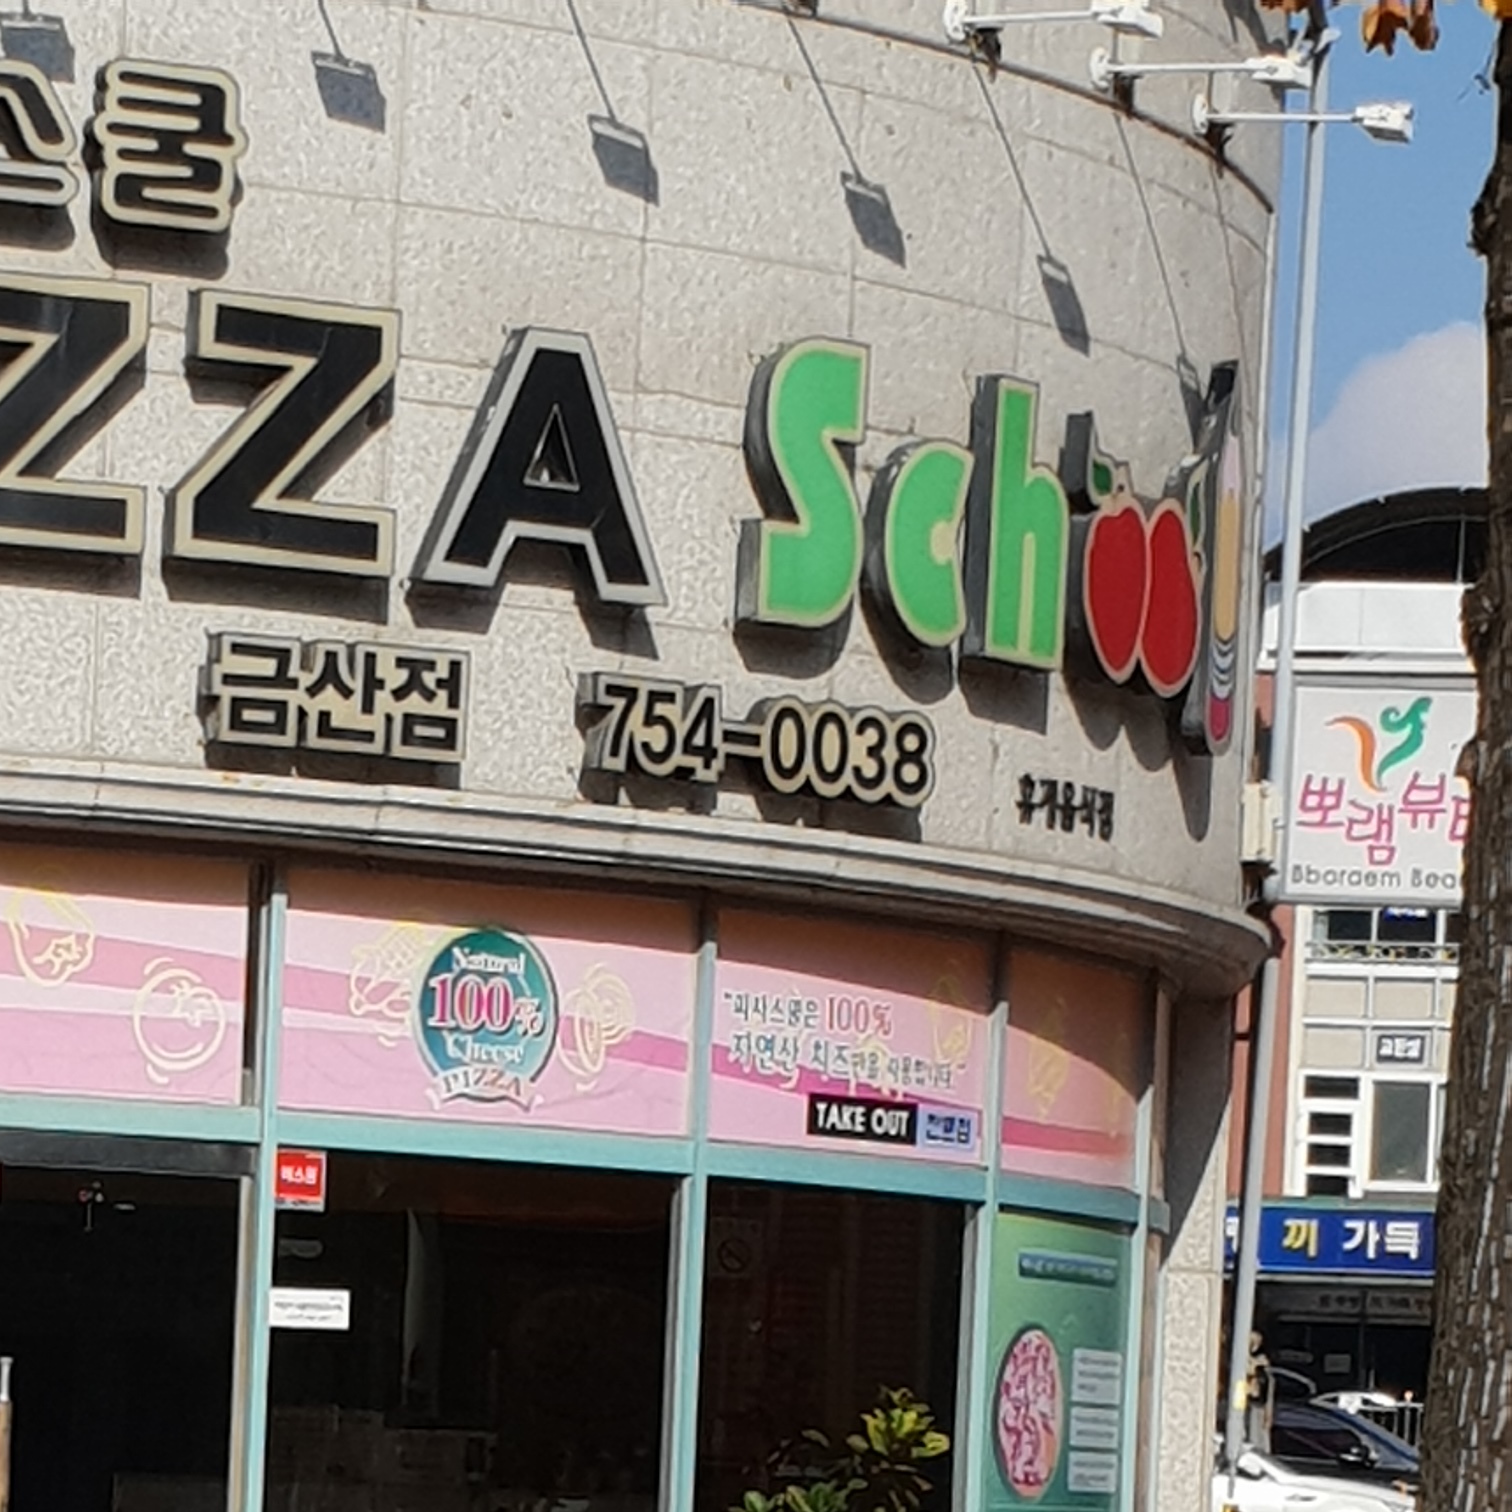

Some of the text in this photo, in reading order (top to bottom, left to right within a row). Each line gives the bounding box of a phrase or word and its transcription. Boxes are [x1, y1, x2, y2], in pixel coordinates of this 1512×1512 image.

[212, 633, 468, 765] 금산점
[592, 674, 936, 806] 754-0038
[427, 972, 545, 1038] 100%
[826, 995, 894, 1037] 100%
[442, 1066, 523, 1097] PIZZA
[815, 1101, 911, 1137] TAKE OUT
[1342, 1220, 1420, 1261] 가득
